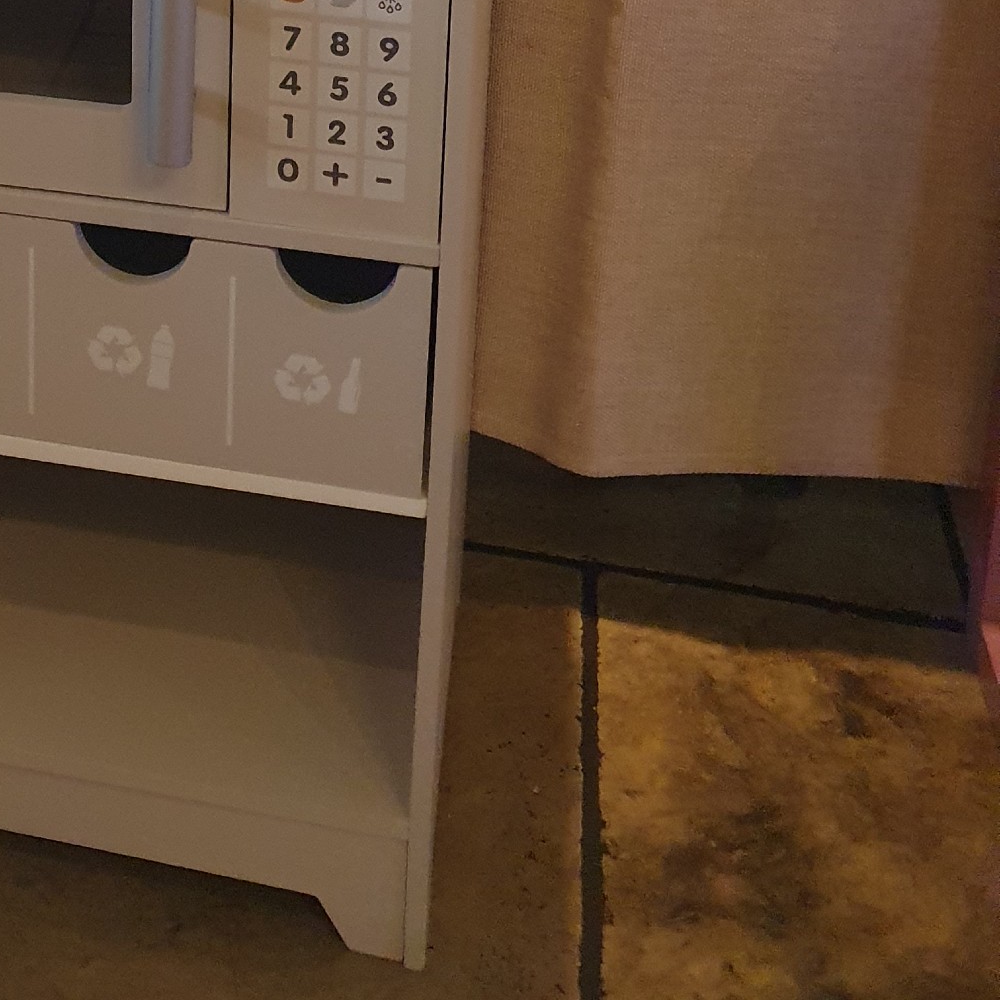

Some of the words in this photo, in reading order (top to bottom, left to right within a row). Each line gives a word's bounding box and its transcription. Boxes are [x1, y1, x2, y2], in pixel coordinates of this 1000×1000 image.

[284, 25, 301, 51] 7
[330, 31, 350, 57] 8
[379, 37, 400, 62] 9
[278, 70, 301, 96] 4
[329, 75, 349, 101] 5
[377, 82, 398, 107] 6
[282, 113, 294, 139] 1
[328, 119, 347, 145] 2
[375, 125, 395, 151] 3
